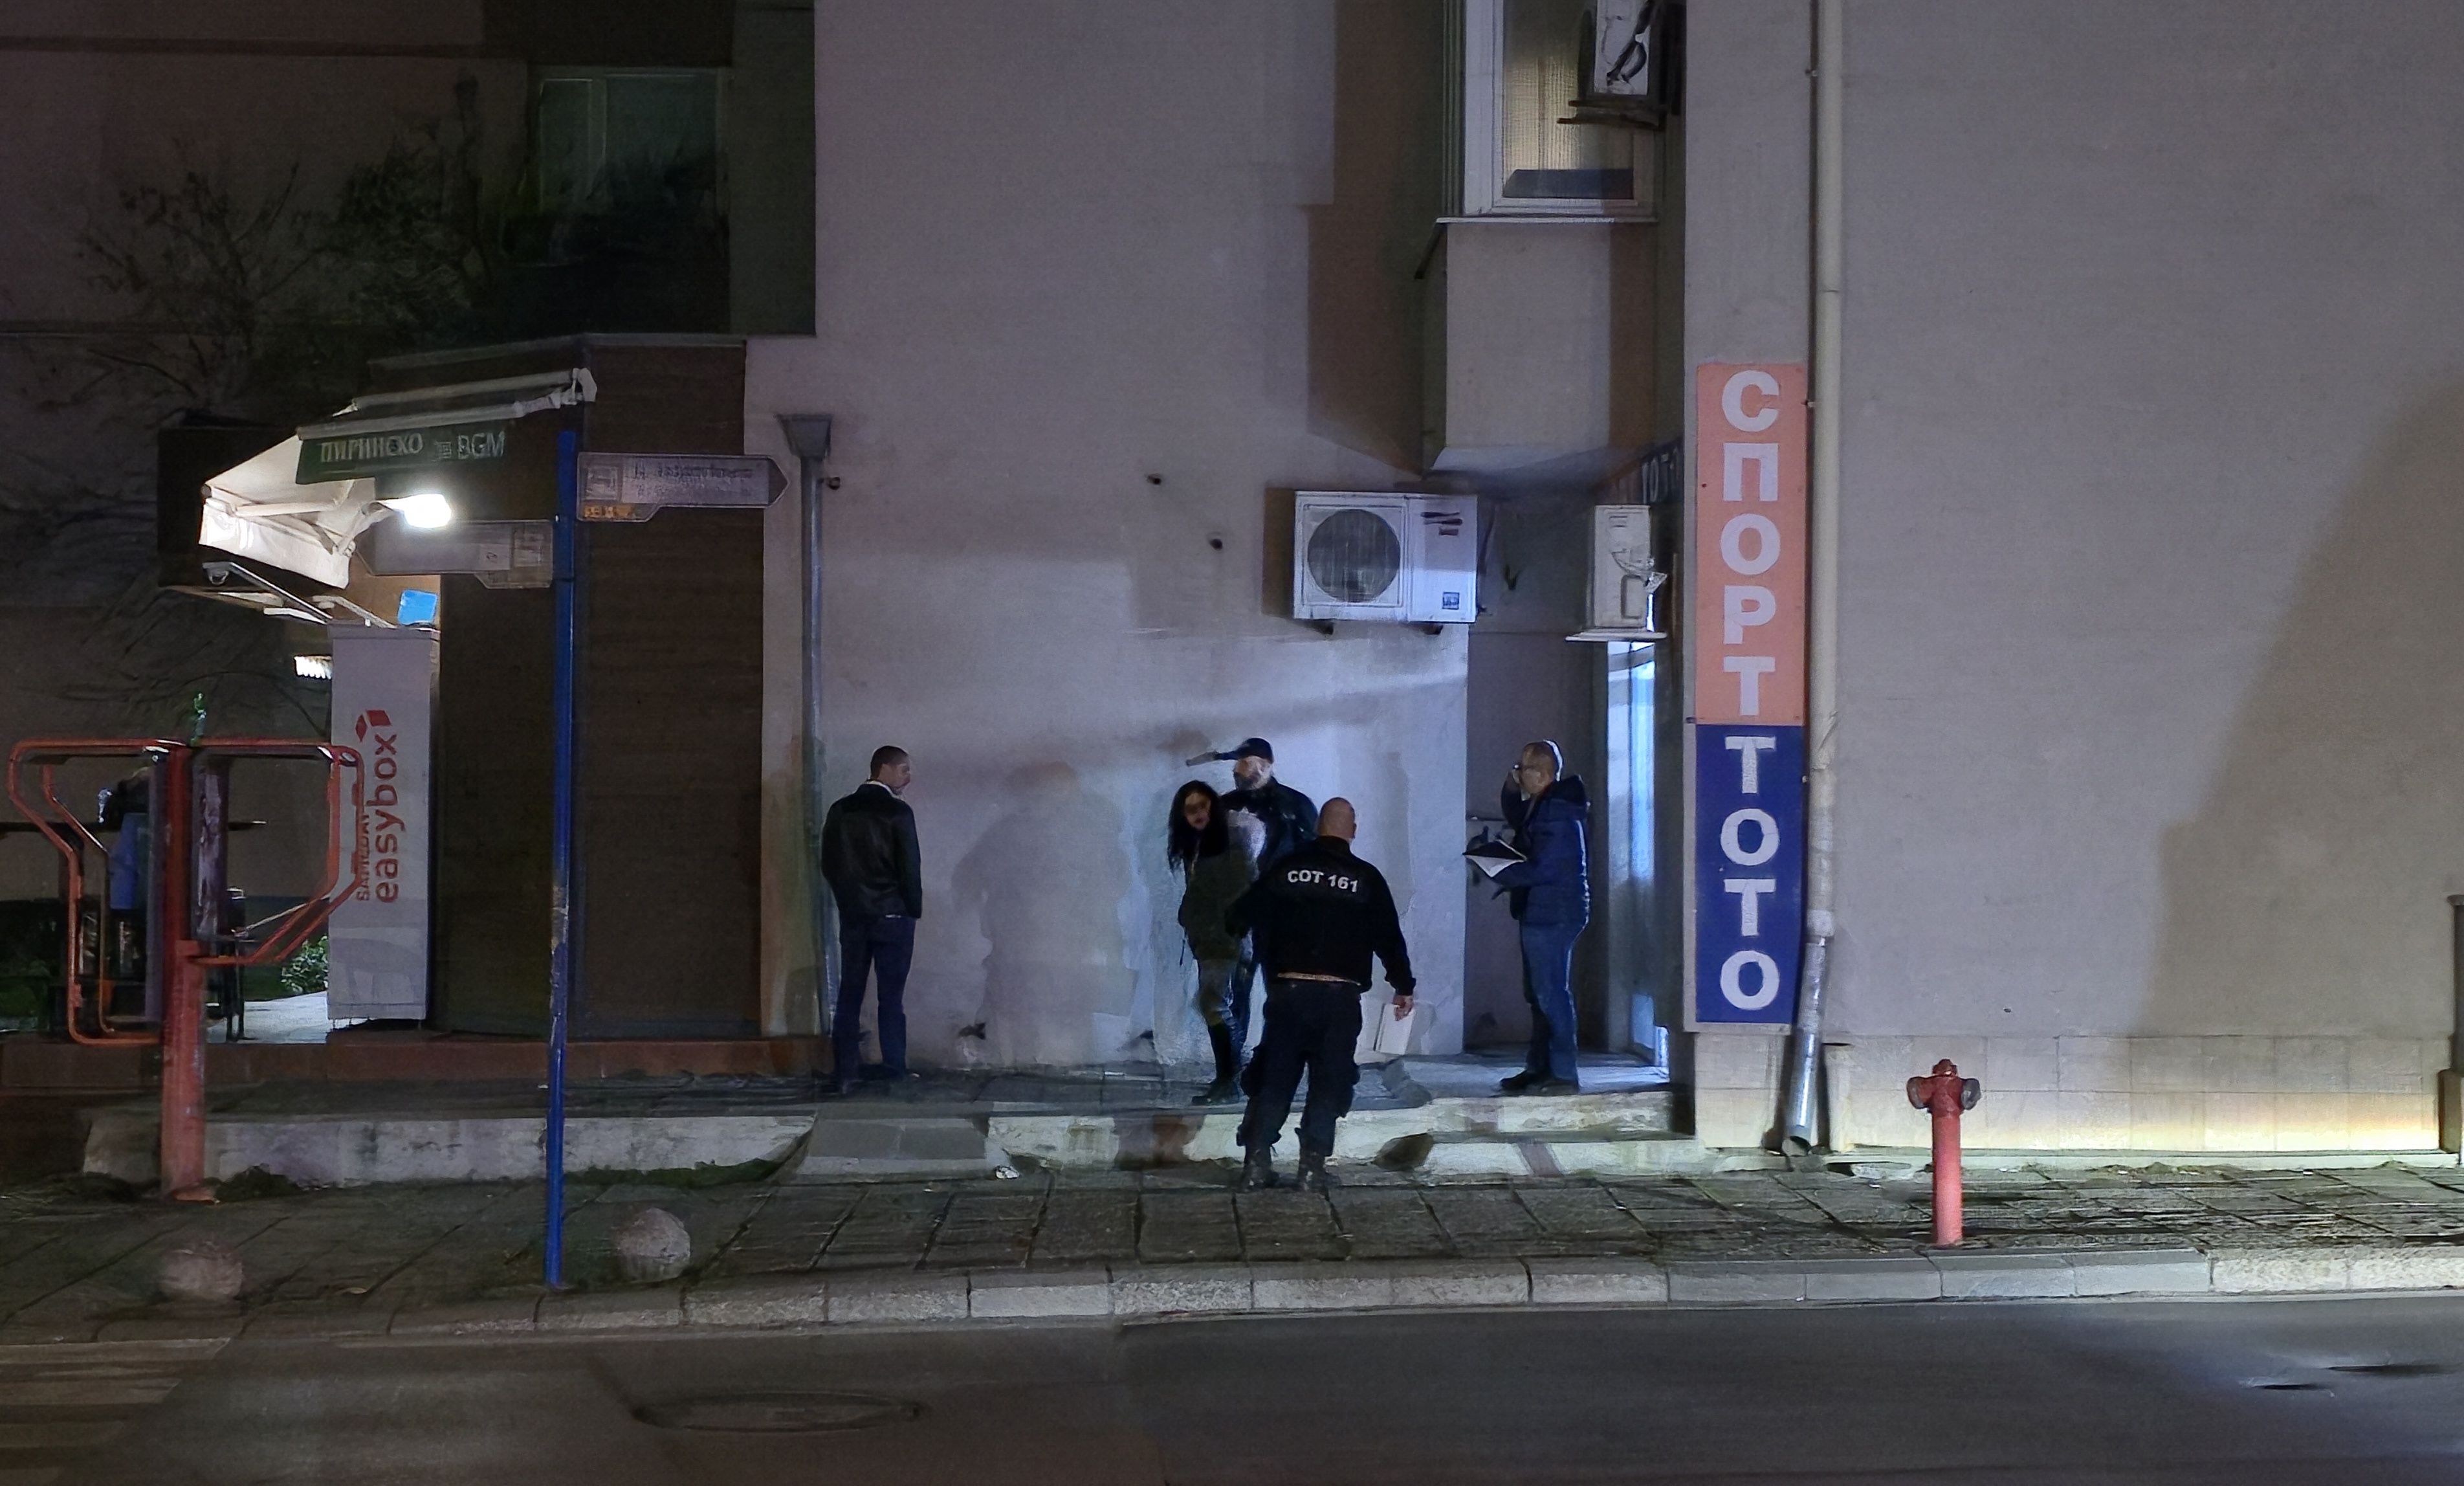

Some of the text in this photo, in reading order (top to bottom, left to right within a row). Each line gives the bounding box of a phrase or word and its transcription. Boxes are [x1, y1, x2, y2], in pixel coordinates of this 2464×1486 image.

[1719, 369, 1780, 1010] СПОРТ ТОТО
[366, 732, 406, 904] easybox
[1287, 870, 1358, 893] СОТ 161
